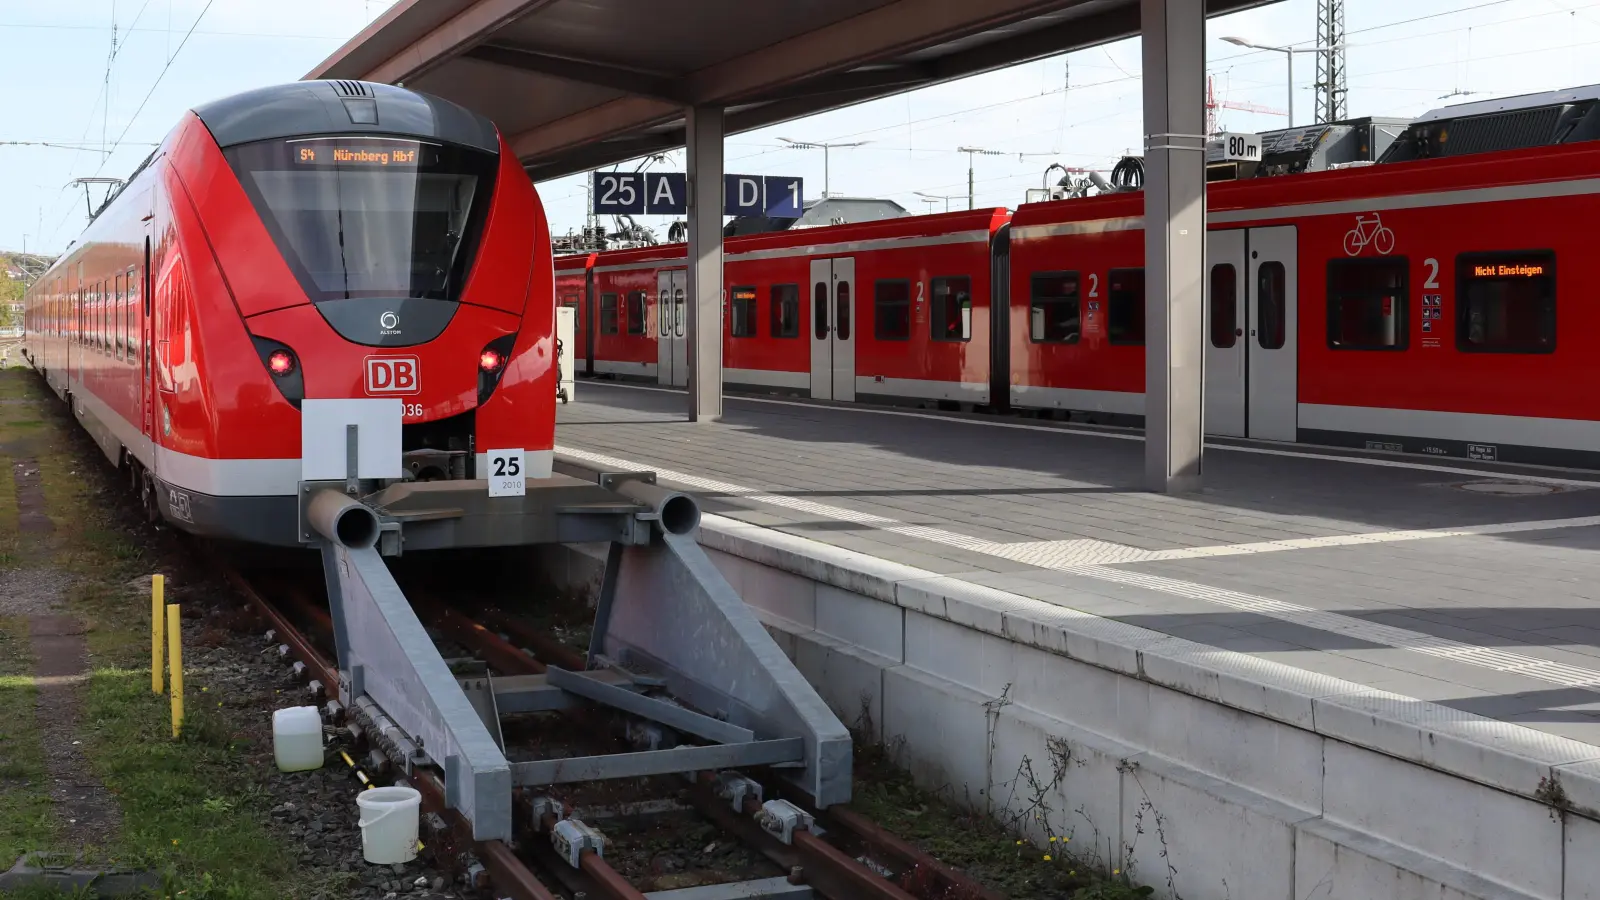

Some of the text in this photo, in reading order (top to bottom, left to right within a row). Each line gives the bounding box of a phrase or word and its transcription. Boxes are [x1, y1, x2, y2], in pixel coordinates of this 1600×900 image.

[300, 148, 415, 165] S4 Nürnberg Hbf
[1229, 136, 1257, 157] 80 m
[600, 176, 675, 206] 25 A
[738, 178, 799, 209] D 1
[1423, 257, 1439, 289] 2
[1474, 264, 1543, 277] Nicht Einsteigen
[916, 281, 924, 302] 2
[1088, 273, 1099, 298] 2
[371, 361, 414, 389] DB
[493, 456, 520, 477] 25
[502, 481, 522, 489] 2010
